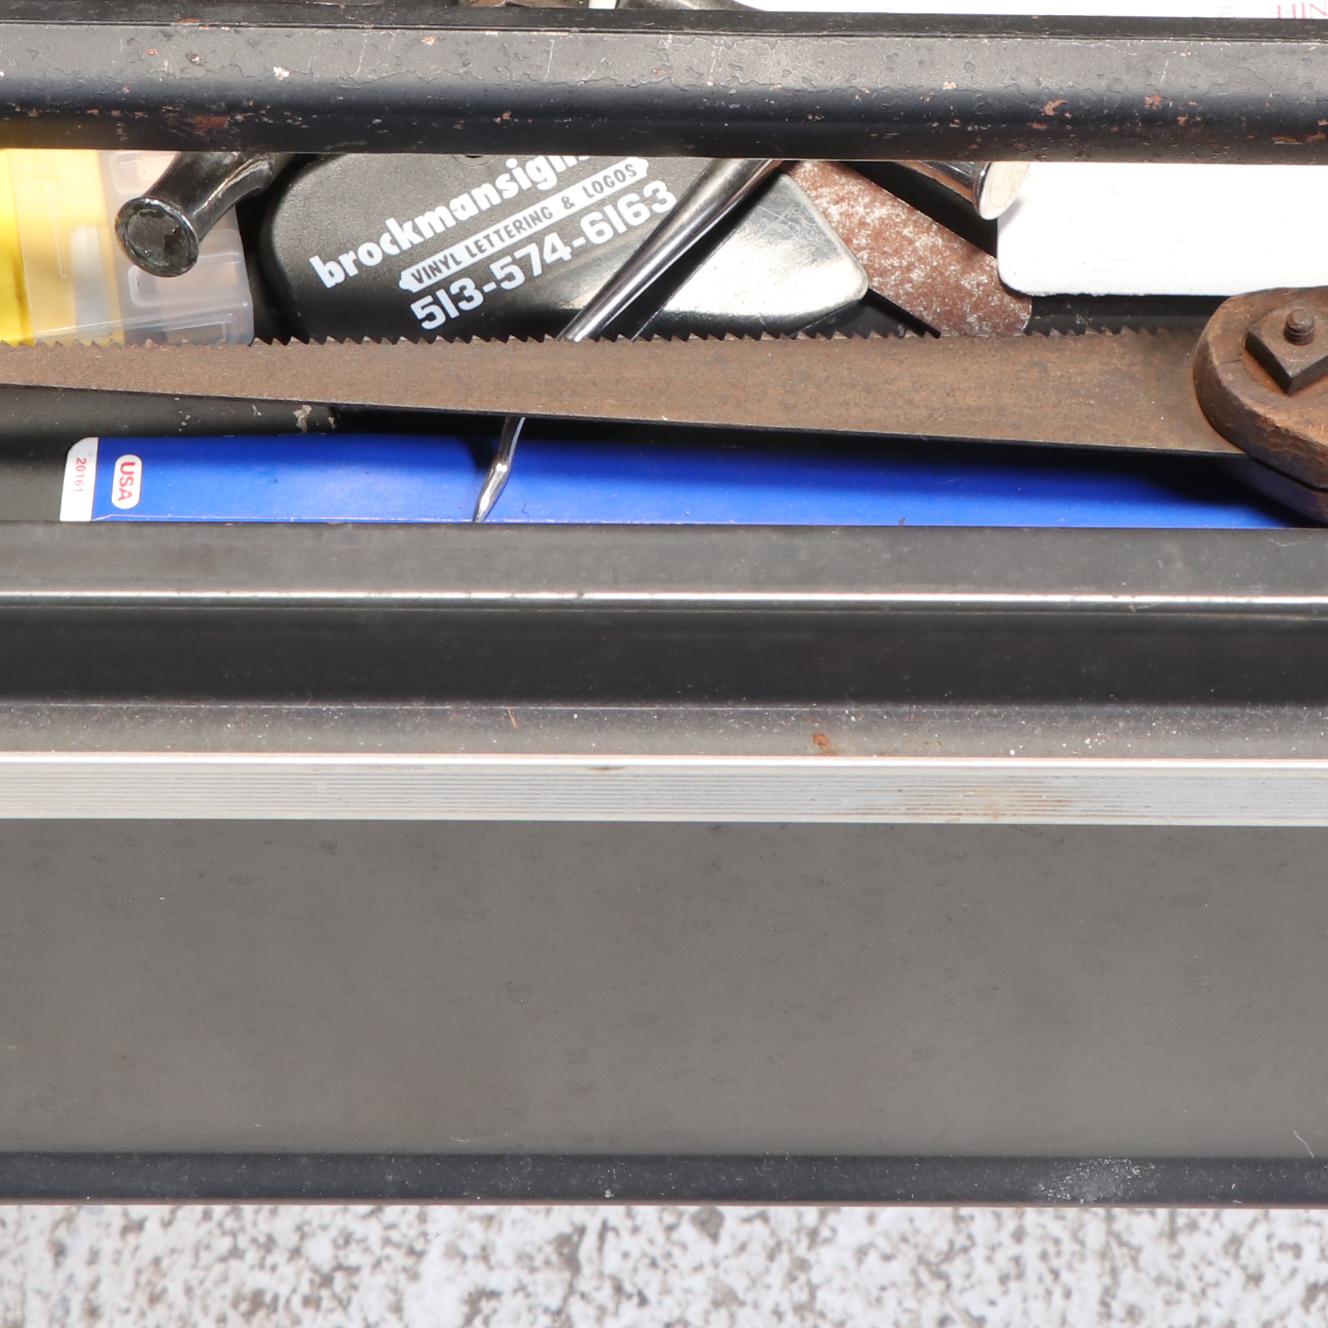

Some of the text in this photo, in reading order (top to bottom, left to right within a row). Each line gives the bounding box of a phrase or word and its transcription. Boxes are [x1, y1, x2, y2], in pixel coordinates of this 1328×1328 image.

[309, 155, 590, 289] brockmansign
[410, 163, 638, 284] VINYL LETTERING & LOGOS
[410, 179, 678, 331] 513-574-6163
[73, 457, 88, 493] 20161
[117, 461, 136, 501] USA
